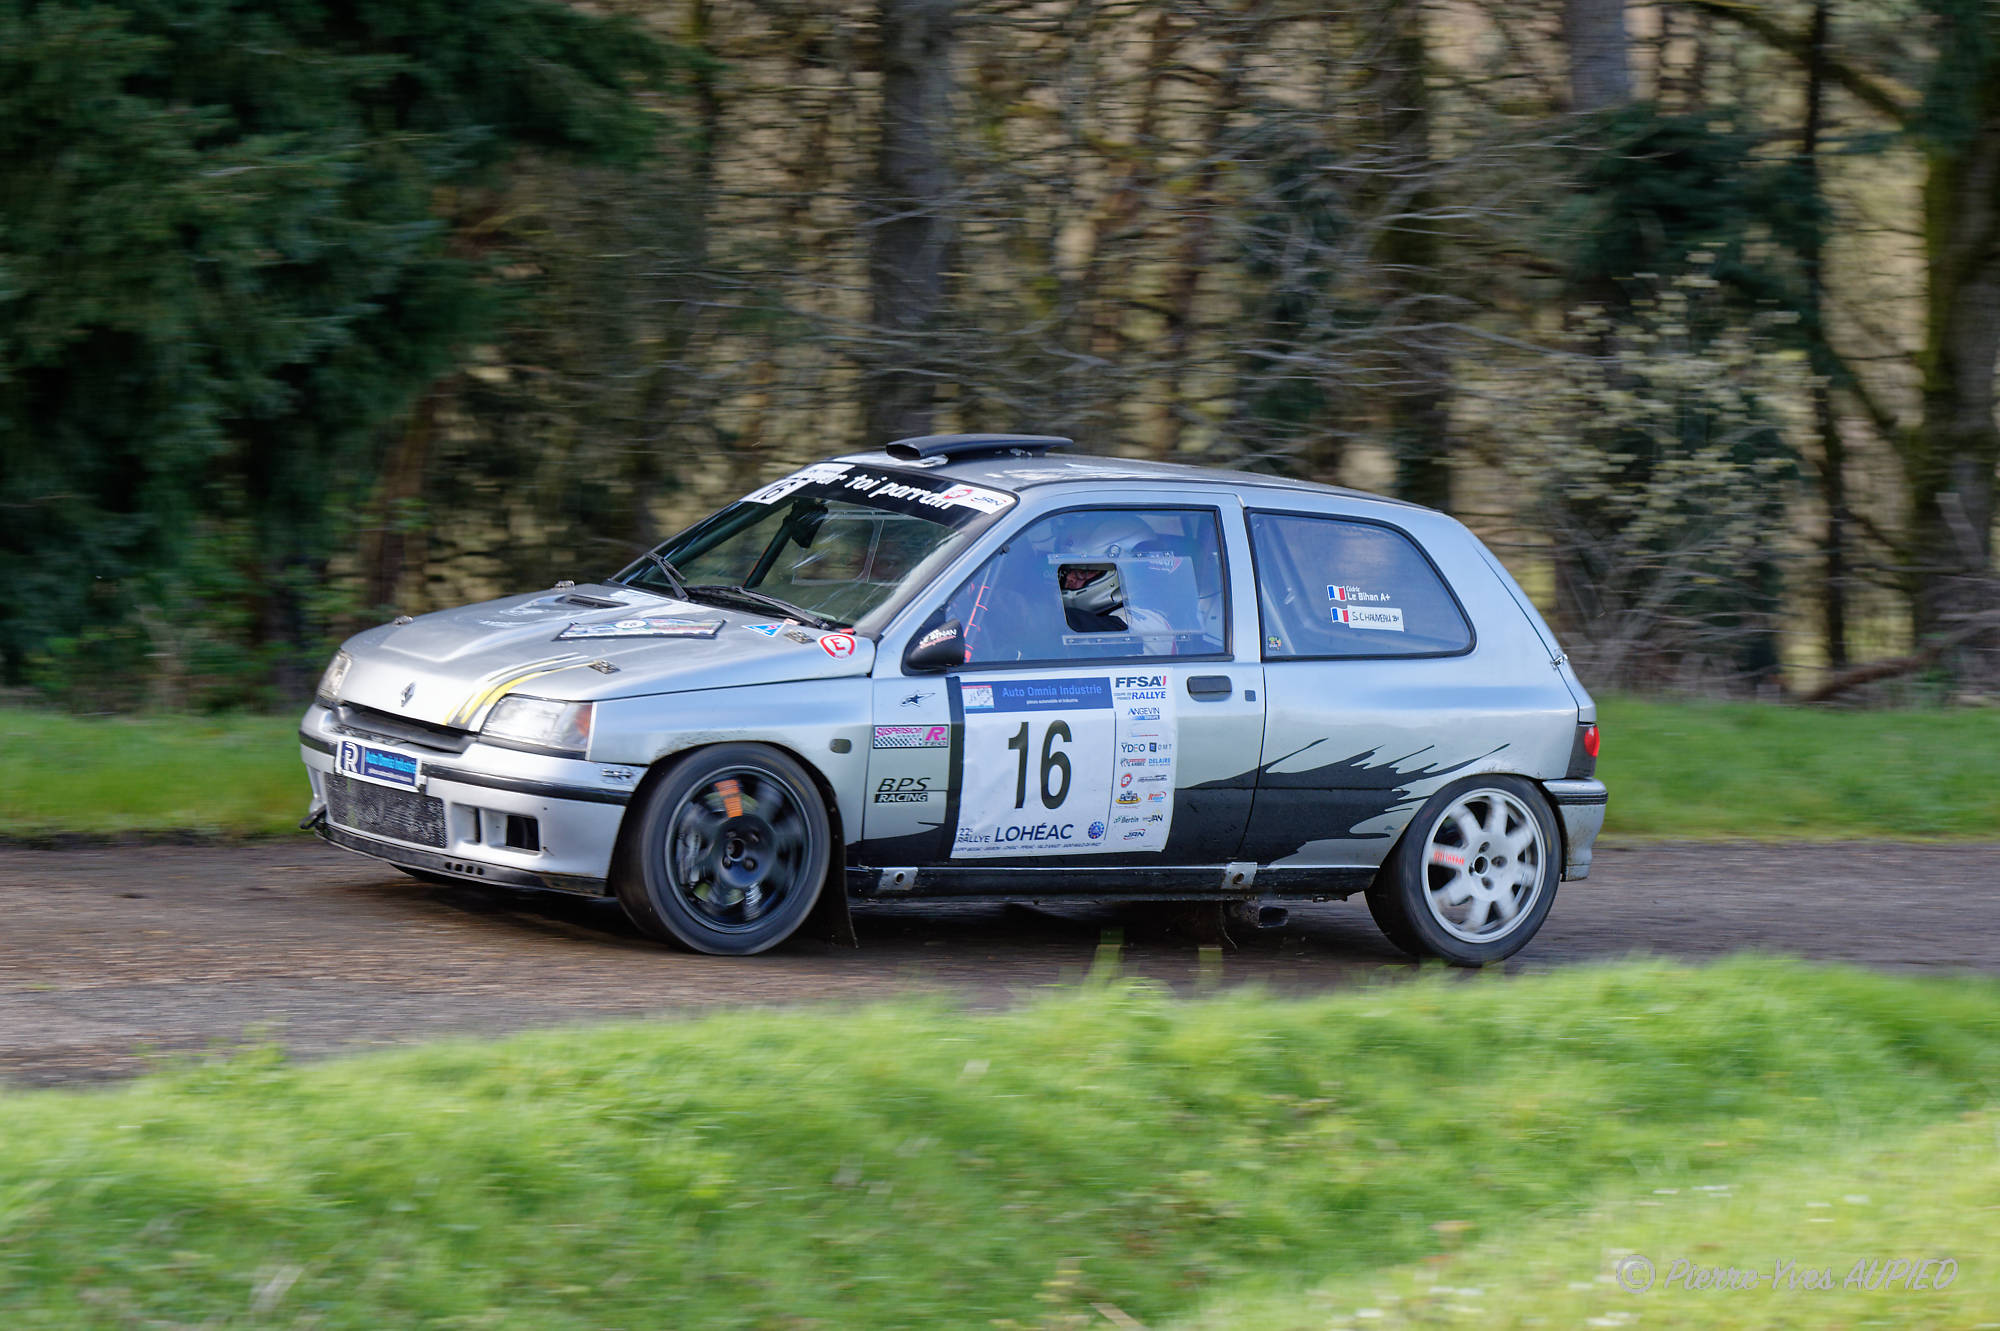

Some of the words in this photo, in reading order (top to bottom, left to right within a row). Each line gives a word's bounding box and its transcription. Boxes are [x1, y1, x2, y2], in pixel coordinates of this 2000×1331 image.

[845, 474, 888, 490] toi
[1347, 592, 1357, 601] Le
[1358, 591, 1379, 601] Bihan
[1115, 675, 1162, 688] FFSA
[1002, 687, 1025, 697] Auto
[1027, 685, 1057, 697] Omnia
[1059, 683, 1102, 696] Industrie
[1131, 690, 1166, 700] RALLYE
[1007, 720, 1073, 811] 16
[878, 777, 932, 792] BPS
[878, 792, 929, 803] RACING
[957, 835, 991, 843] RALLYE
[994, 822, 1075, 843] LOHÉAC
